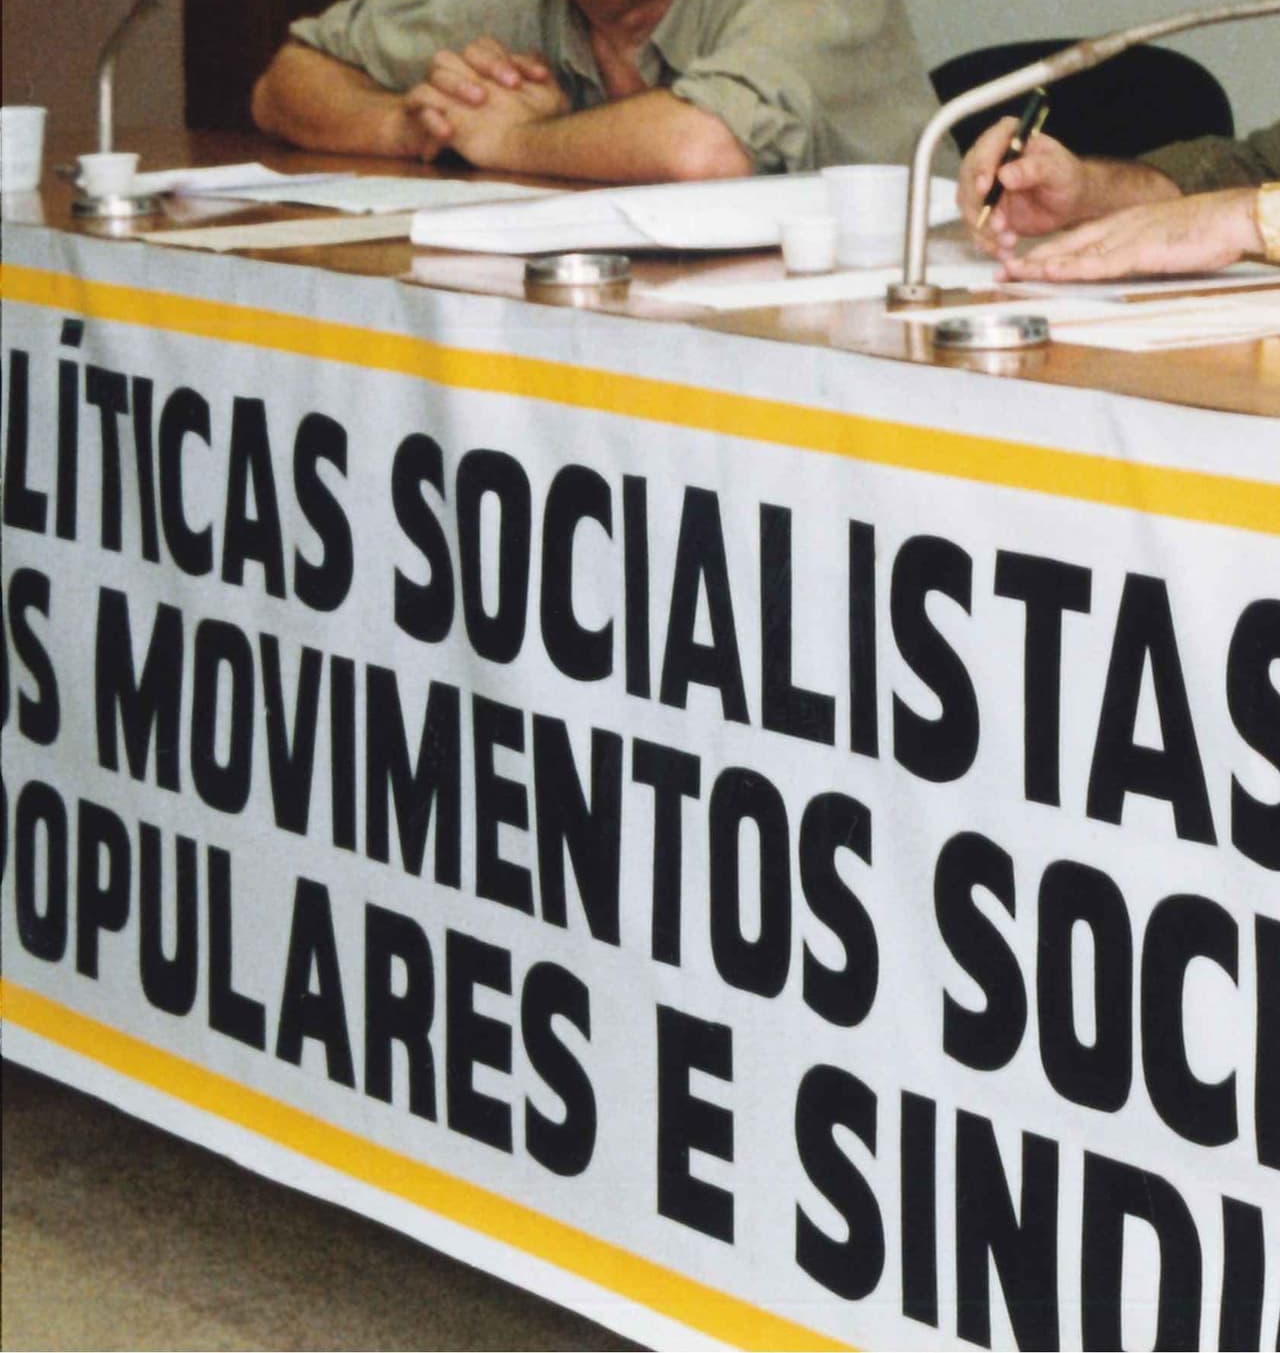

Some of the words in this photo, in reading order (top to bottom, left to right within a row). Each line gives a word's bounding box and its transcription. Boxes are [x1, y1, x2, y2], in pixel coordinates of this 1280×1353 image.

[1, 566, 61, 746] S
[95, 586, 879, 1028] MOVIMENTOS
[1, 768, 597, 1177] OPULARES
[657, 1005, 734, 1244] E
